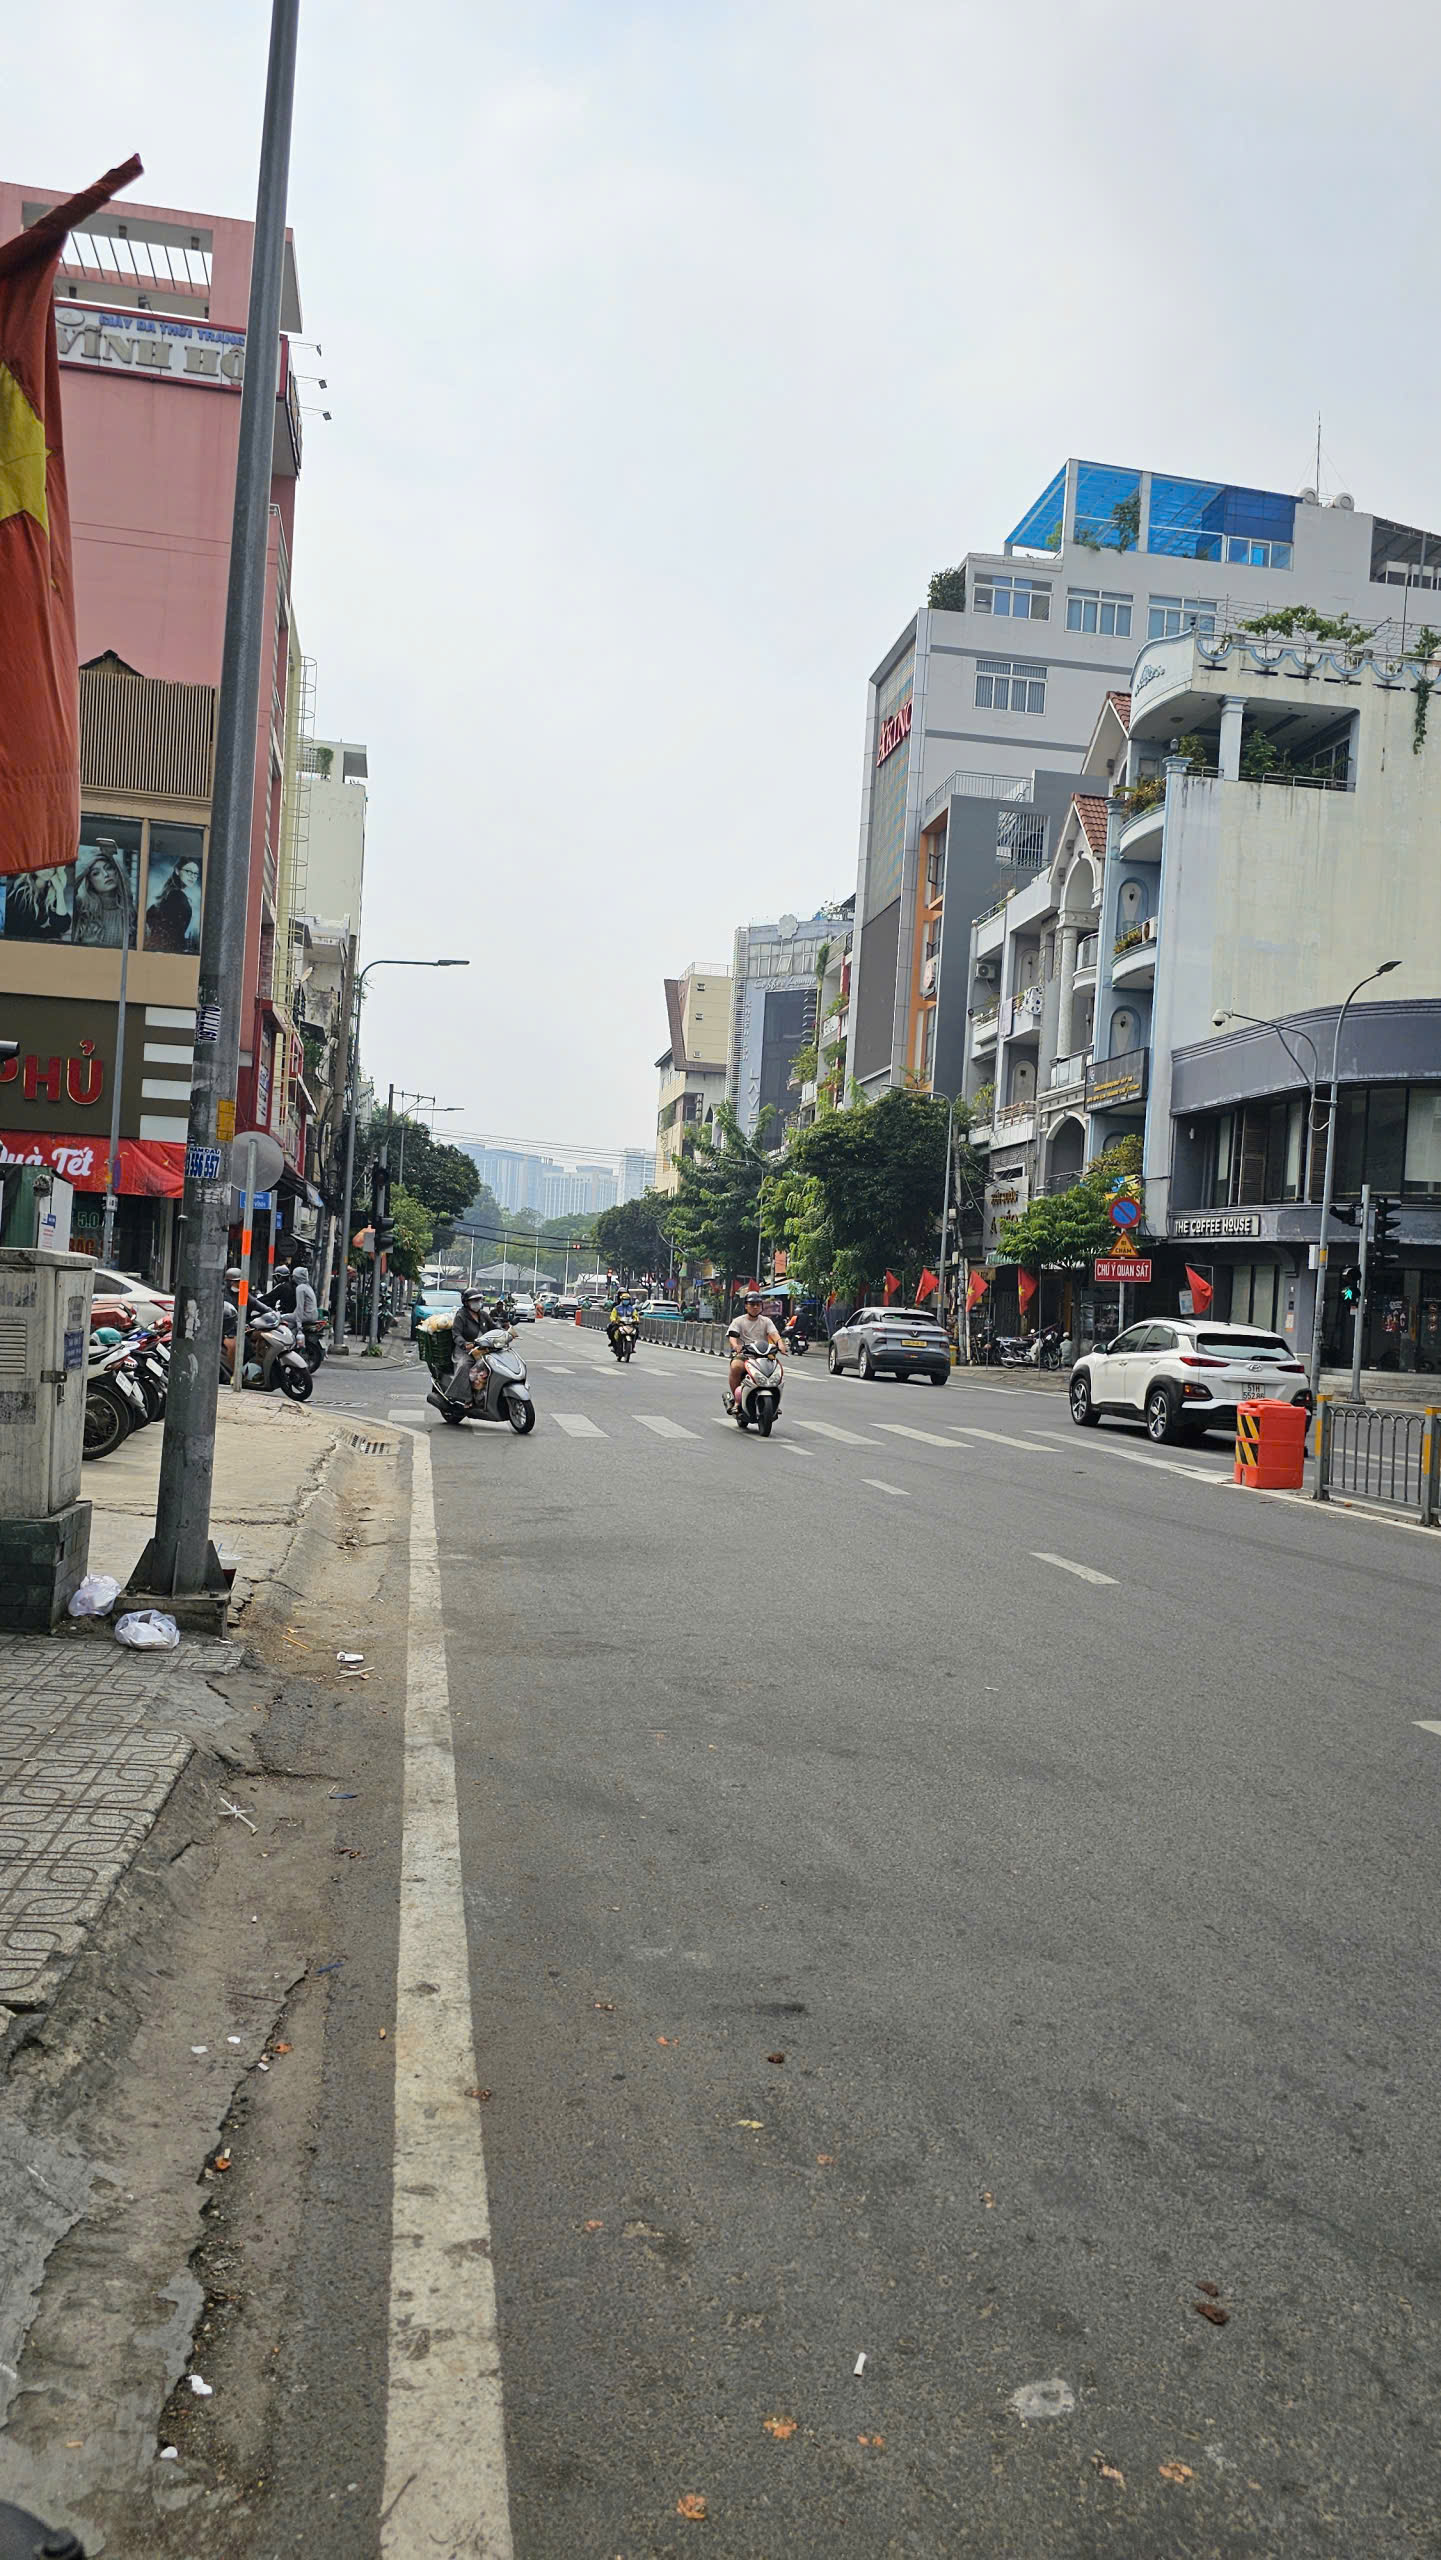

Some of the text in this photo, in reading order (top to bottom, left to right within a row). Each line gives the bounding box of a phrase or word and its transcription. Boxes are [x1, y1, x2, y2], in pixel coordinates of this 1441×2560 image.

[56, 323, 173, 370] VĨNH
[52, 1147, 94, 1176] Tết
[1175, 1217, 1251, 1234] THE COFFEE HOUSE
[1097, 1261, 1149, 1278] CHÚ Ý QUAN SÁT
[1247, 1384, 1260, 1393] 51H
